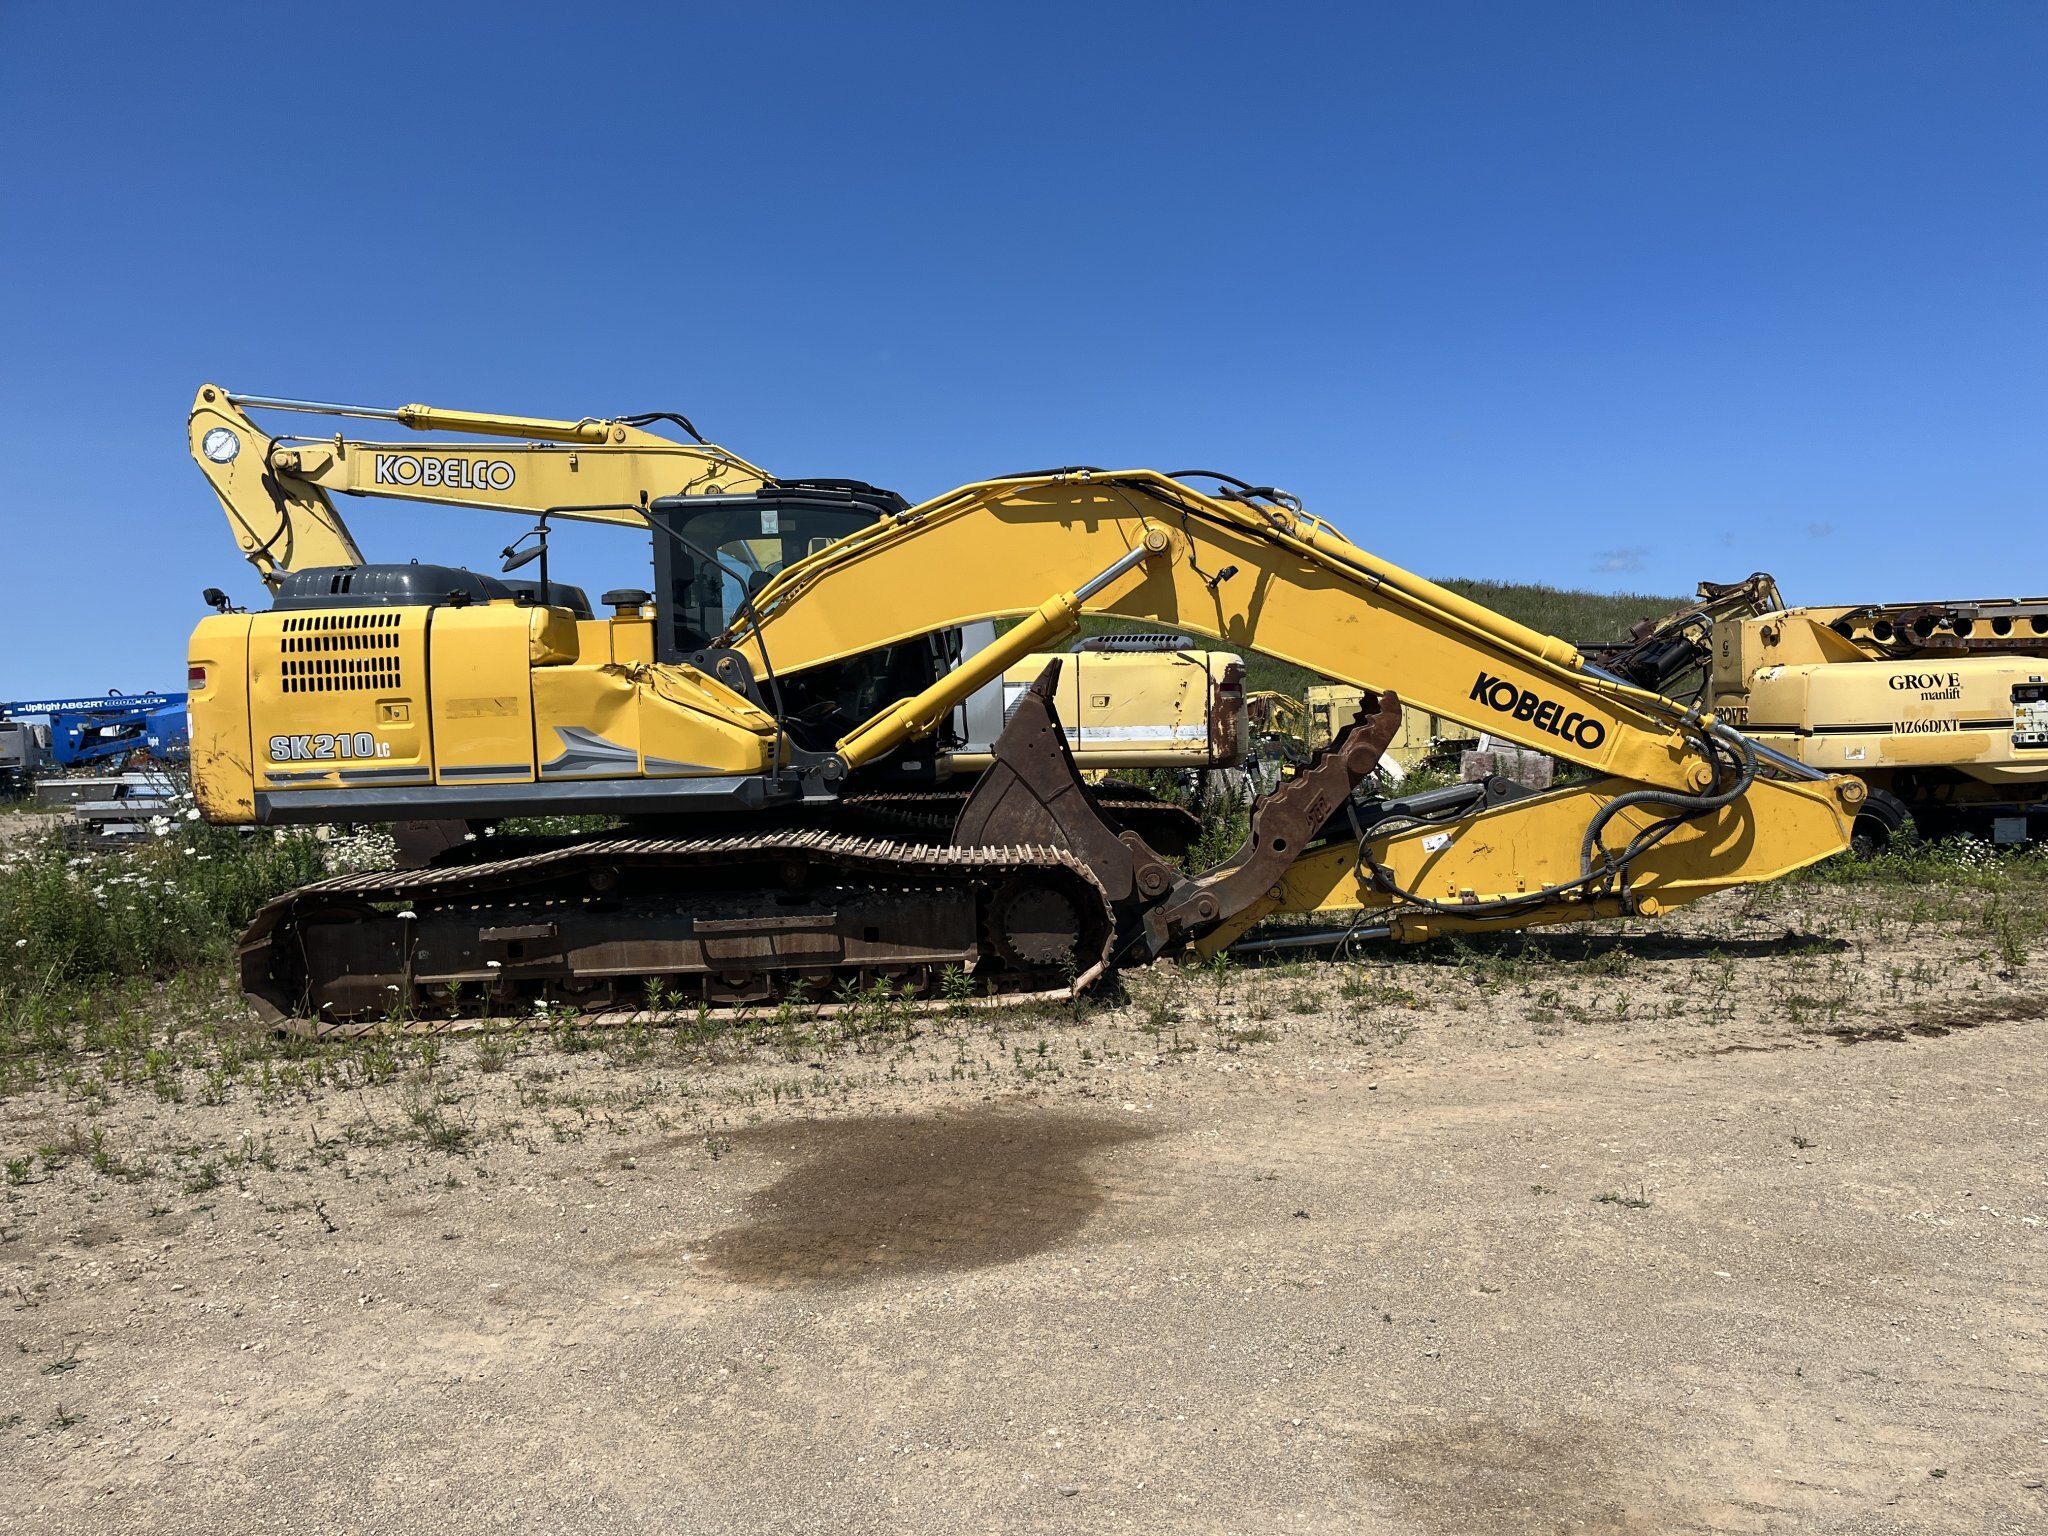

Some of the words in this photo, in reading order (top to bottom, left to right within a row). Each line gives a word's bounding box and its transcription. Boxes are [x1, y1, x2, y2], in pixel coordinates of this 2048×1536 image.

[375, 454, 516, 490] KOBELCO
[1888, 672, 1961, 690] GROVE
[25, 702, 61, 713] UpRight
[61, 700, 104, 710] AB62RT
[1920, 688, 1961, 701] manlift
[1469, 671, 1606, 750] KOBELCO
[269, 731, 376, 761] SK210
